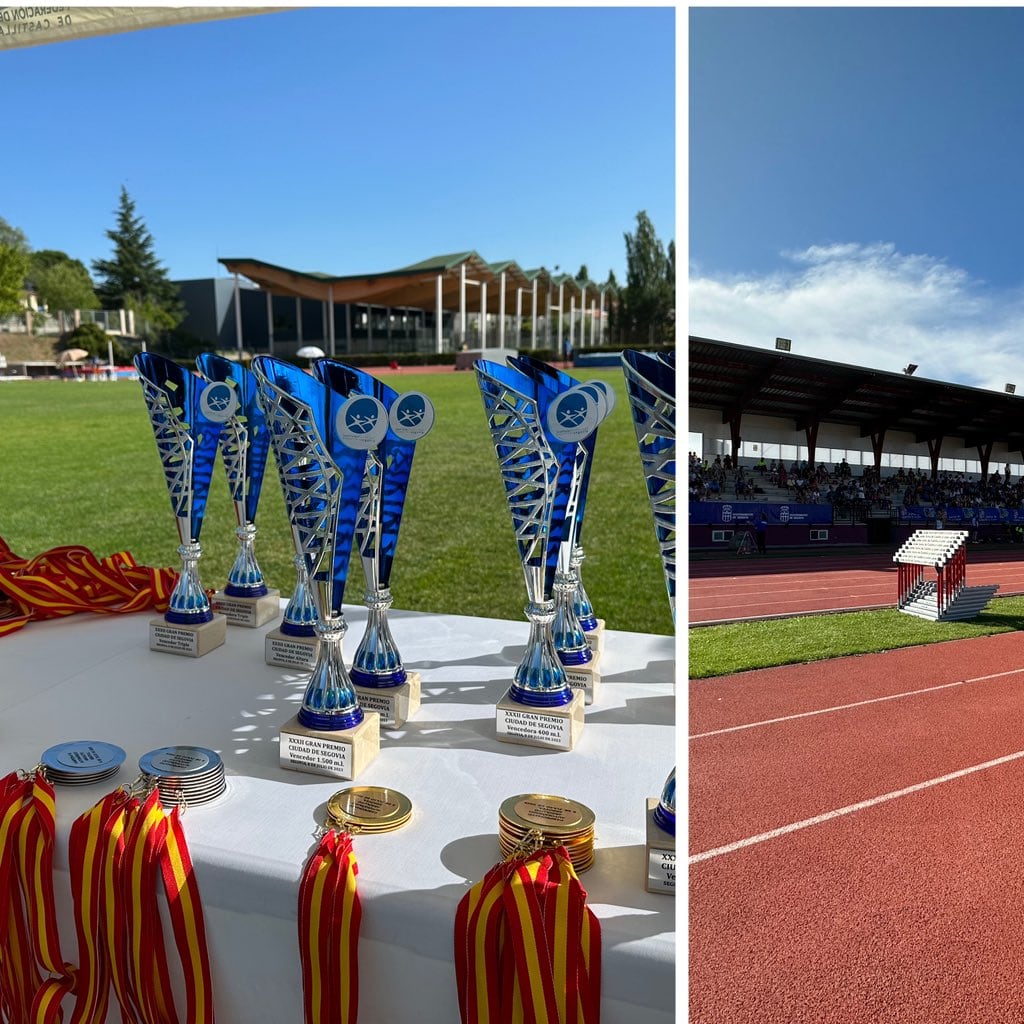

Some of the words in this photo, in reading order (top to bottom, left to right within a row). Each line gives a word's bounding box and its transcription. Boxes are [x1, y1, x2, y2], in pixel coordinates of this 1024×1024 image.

[369, 696, 390, 705] PREMIO
[368, 703, 390, 711] SEGOVIA
[505, 710, 521, 718] XXXII
[522, 713, 539, 721] GRAN
[539, 716, 564, 724] PREMIO
[505, 717, 528, 726] CIUDAD
[538, 722, 563, 731] SEGOVIA
[506, 724, 537, 734] Vencedora
[305, 740, 321, 748] GRAN
[322, 743, 346, 752] PREMIO
[289, 745, 311, 753] CIUDAD
[320, 750, 346, 760] SEGOVIA
[290, 752, 316, 762] Vencedor
